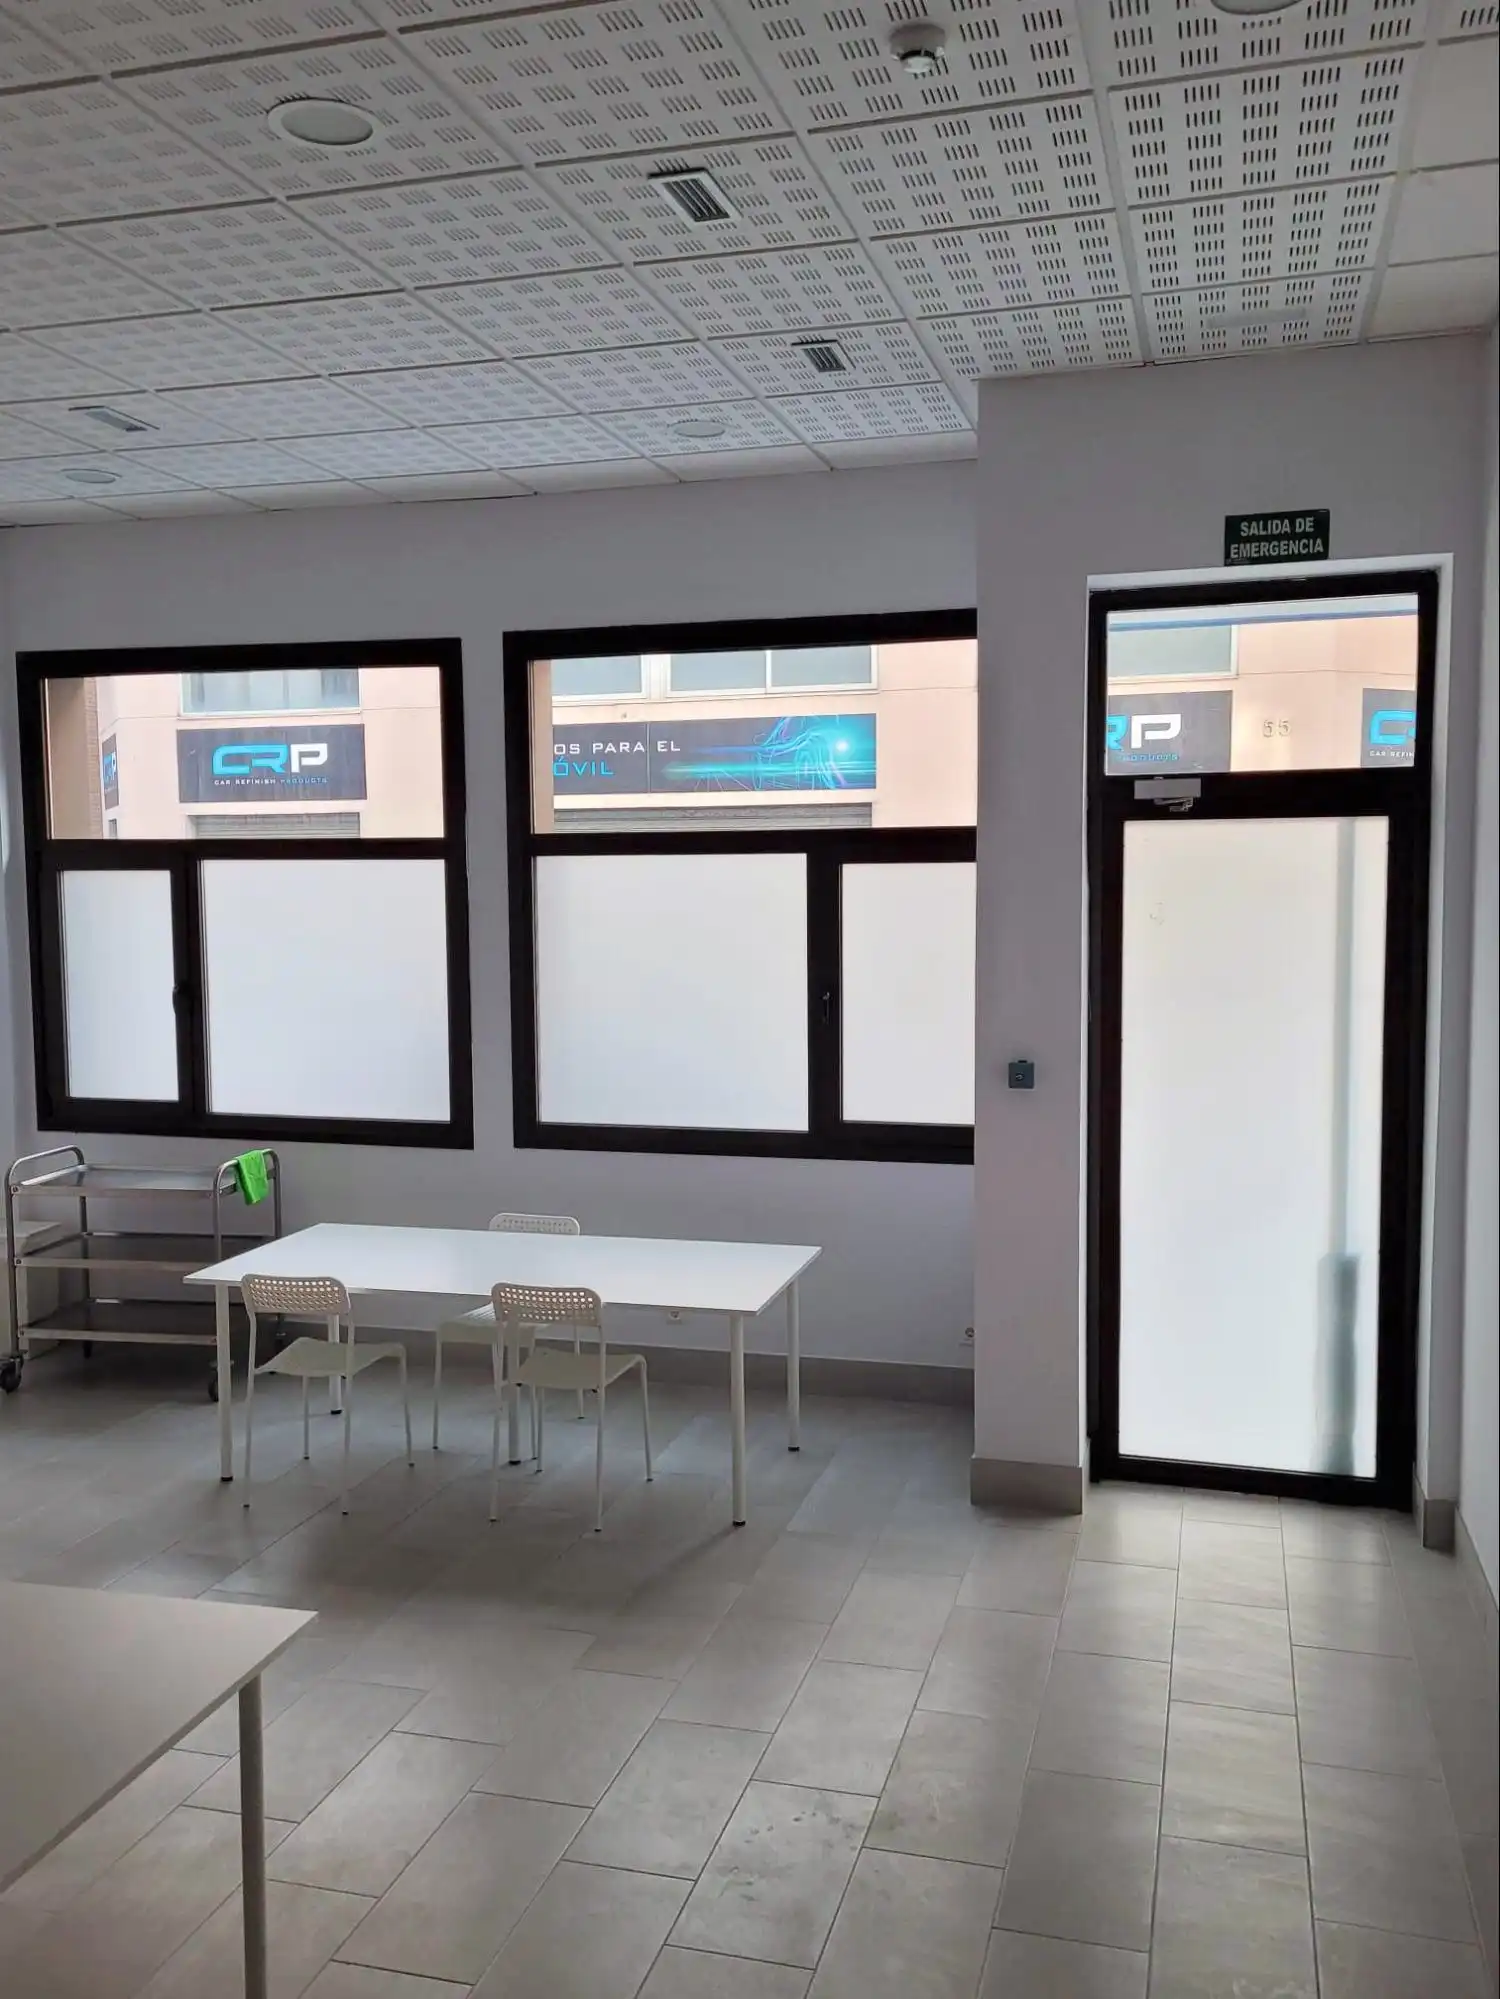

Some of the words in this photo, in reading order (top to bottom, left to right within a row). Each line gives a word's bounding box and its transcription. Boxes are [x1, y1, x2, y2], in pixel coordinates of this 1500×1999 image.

[1240, 519, 1291, 537] SALIDA
[1295, 517, 1315, 533] DE
[1230, 538, 1324, 559] EMERGENCIA
[554, 743, 581, 755] OS
[592, 741, 646, 754] PARA
[657, 740, 681, 752] EL
[212, 743, 328, 775] CRP
